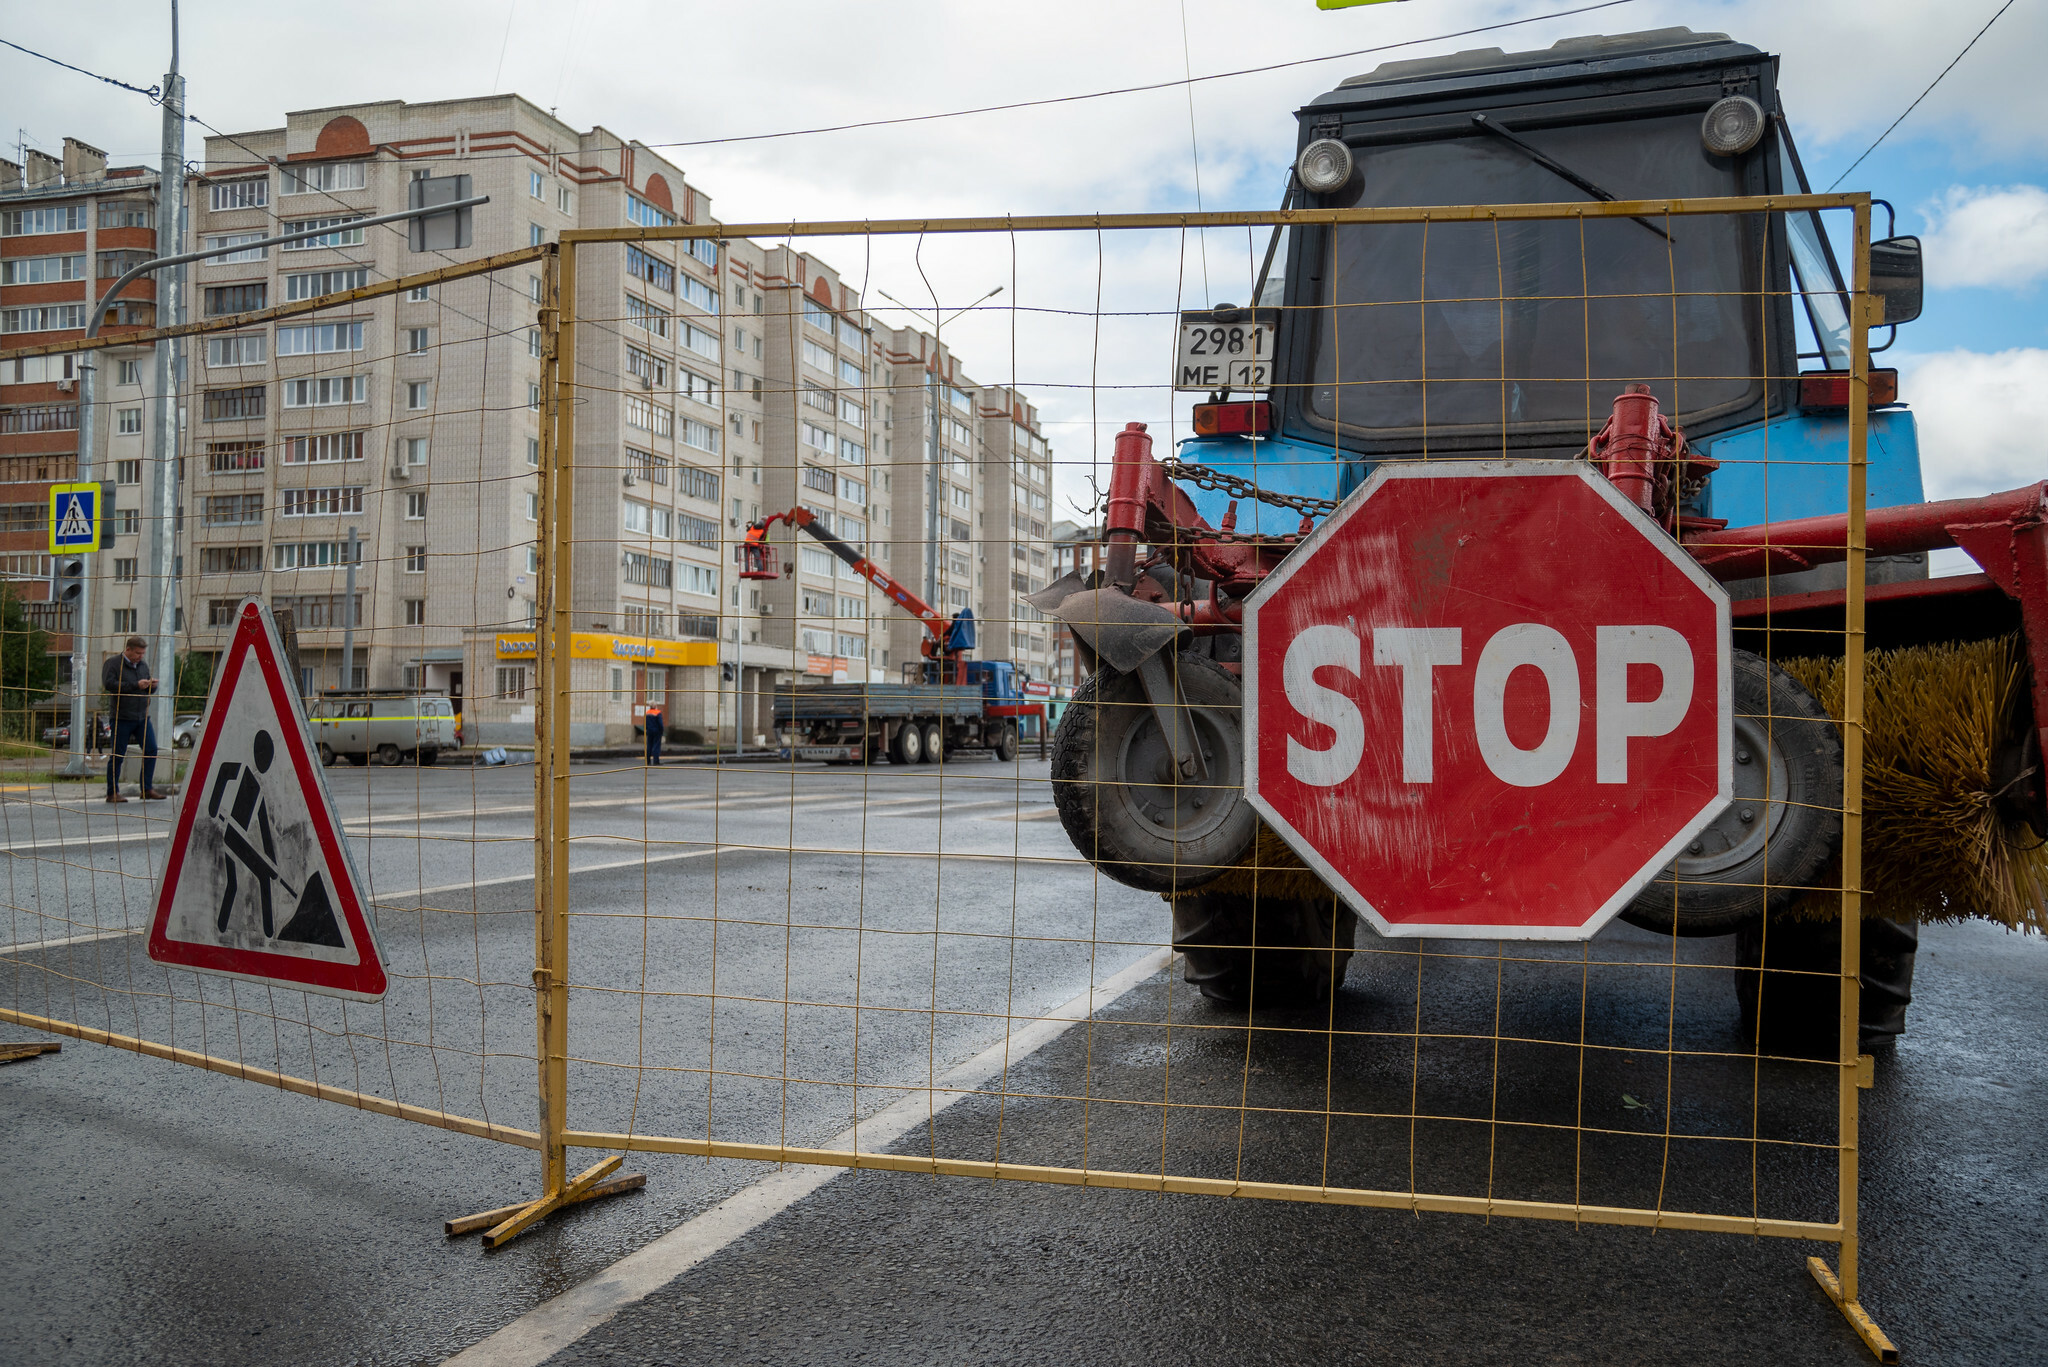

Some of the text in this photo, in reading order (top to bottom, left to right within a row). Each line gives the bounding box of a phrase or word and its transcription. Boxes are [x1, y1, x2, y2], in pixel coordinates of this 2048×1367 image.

[1190, 327, 1263, 355] 2981
[1238, 366, 1265, 386] 12
[1283, 623, 1694, 787] STOP
